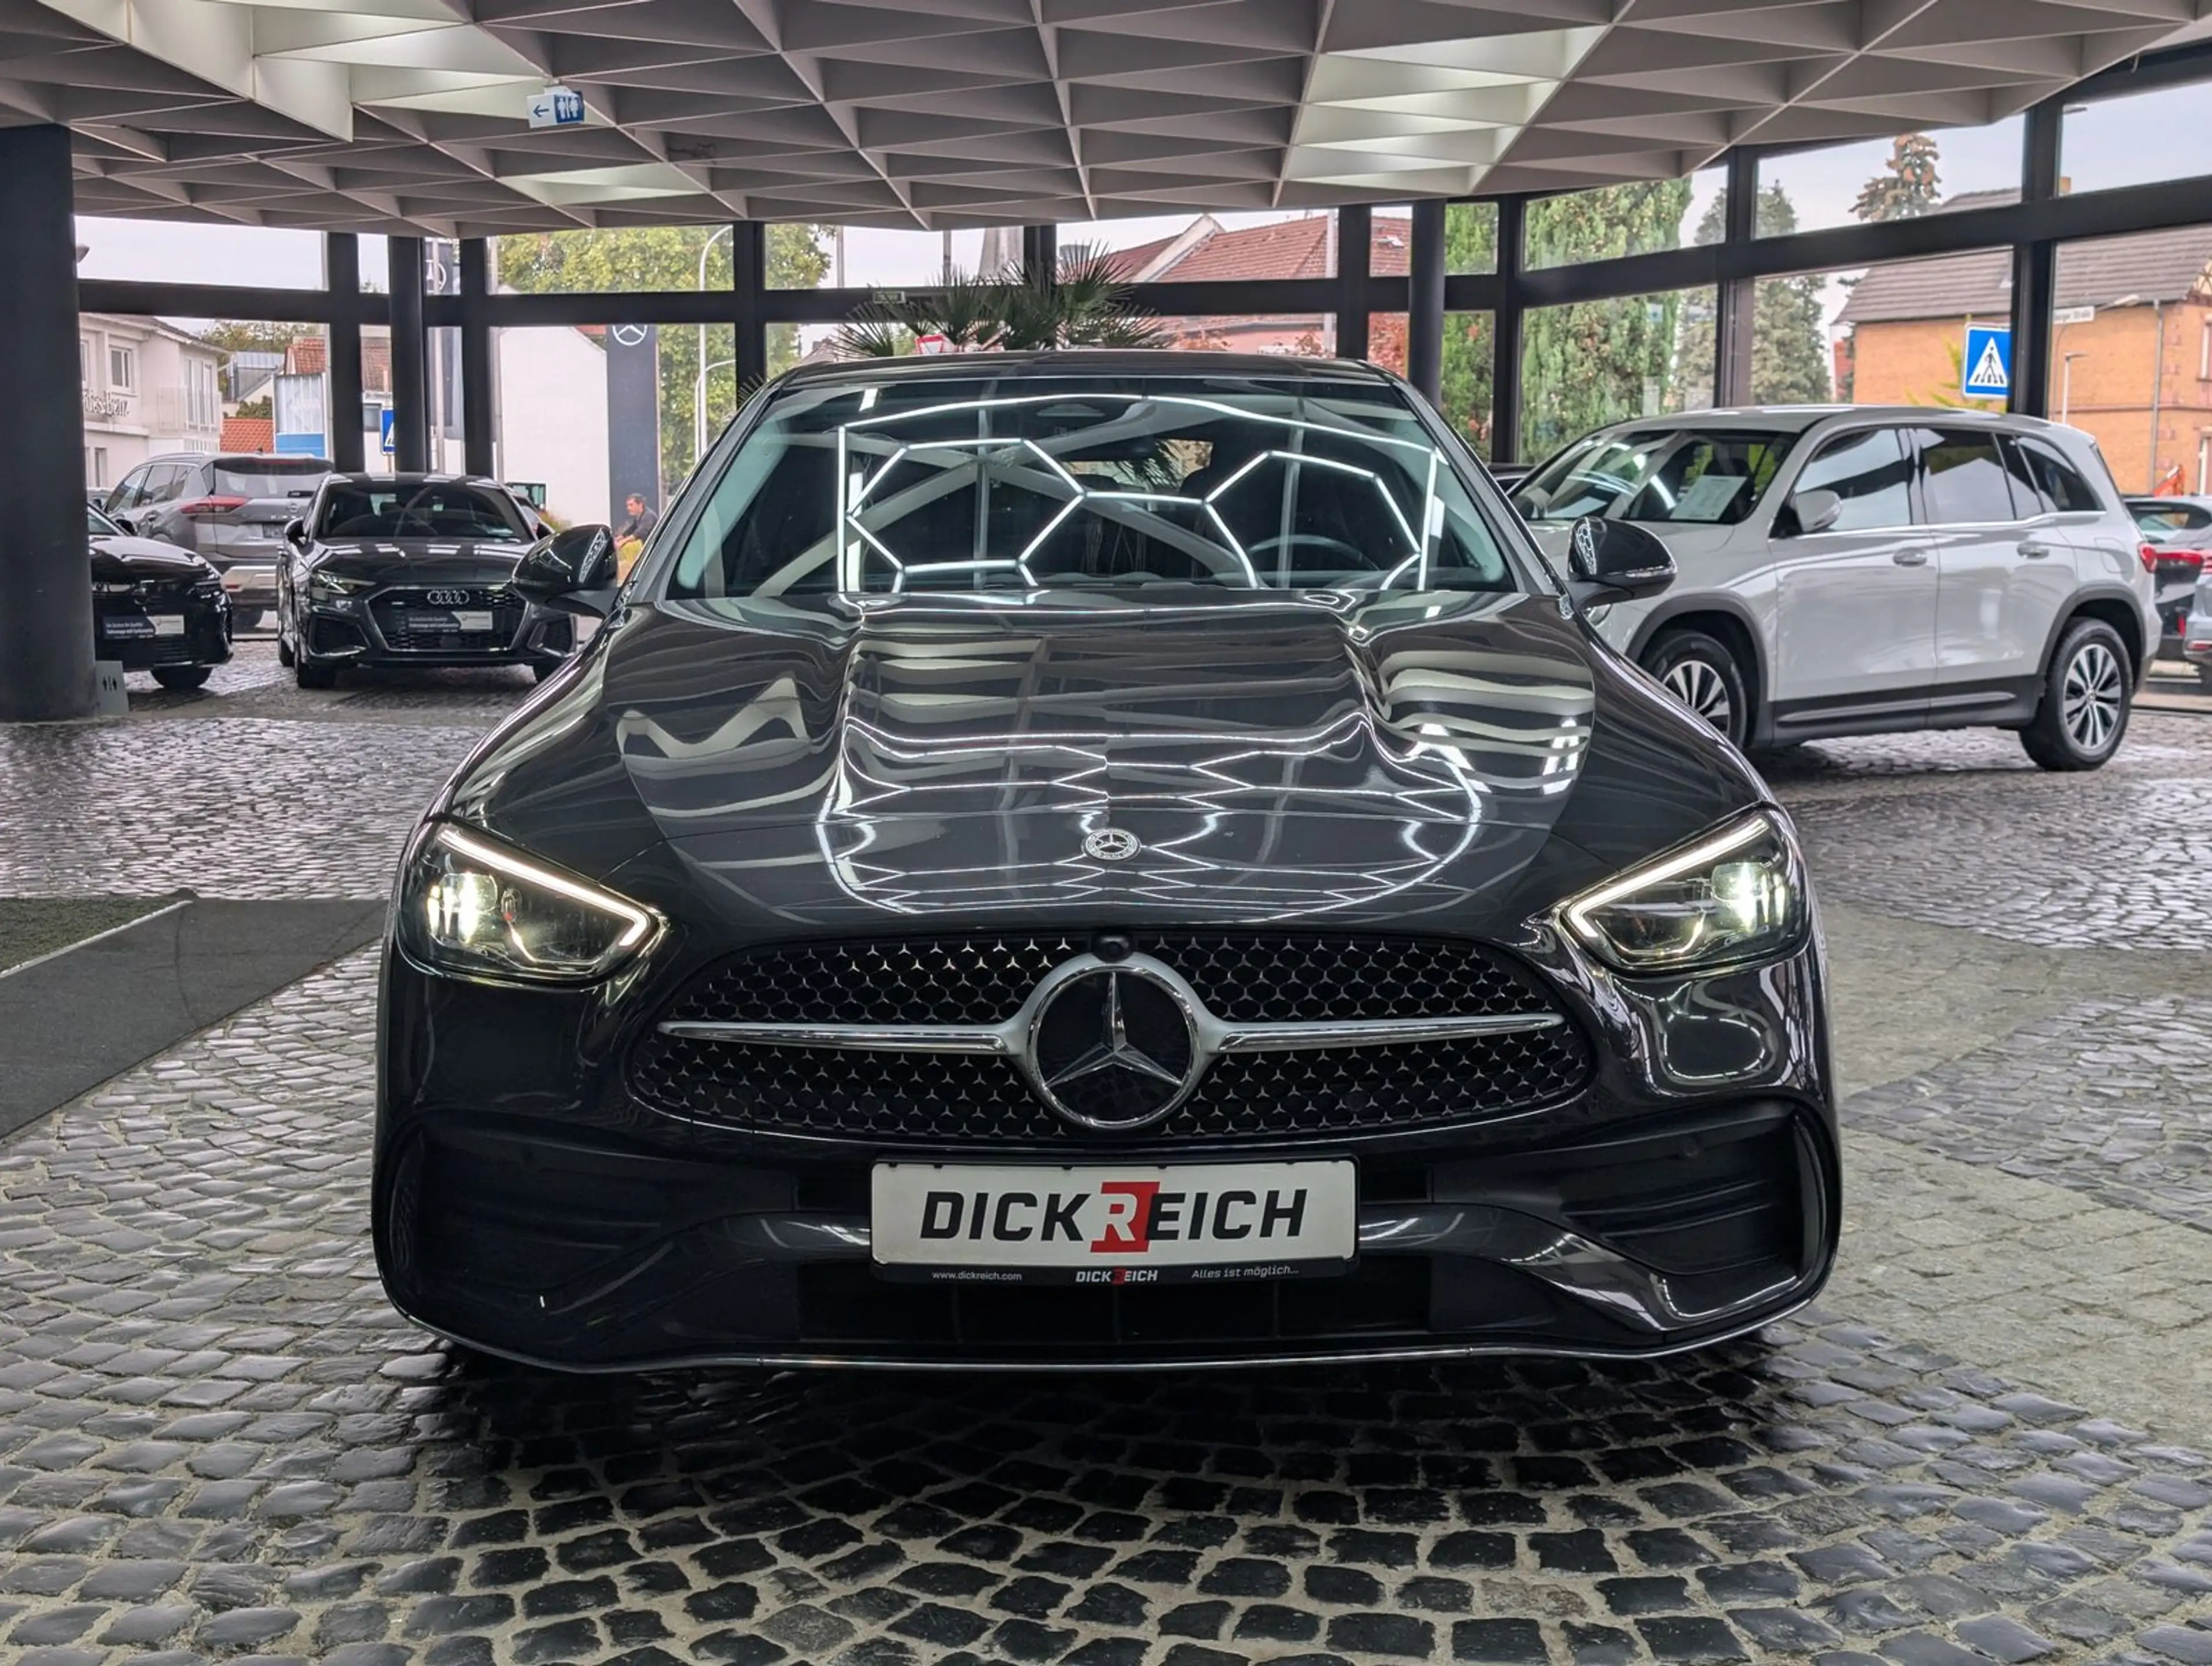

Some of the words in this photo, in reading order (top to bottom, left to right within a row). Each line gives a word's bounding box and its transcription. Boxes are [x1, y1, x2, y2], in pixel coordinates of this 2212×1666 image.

[920, 1188, 1308, 1243] DICKREICH
[932, 1270, 1022, 1281] www.dickreich.com
[1191, 1270, 1221, 1278] Alles
[1224, 1267, 1241, 1277] ist
